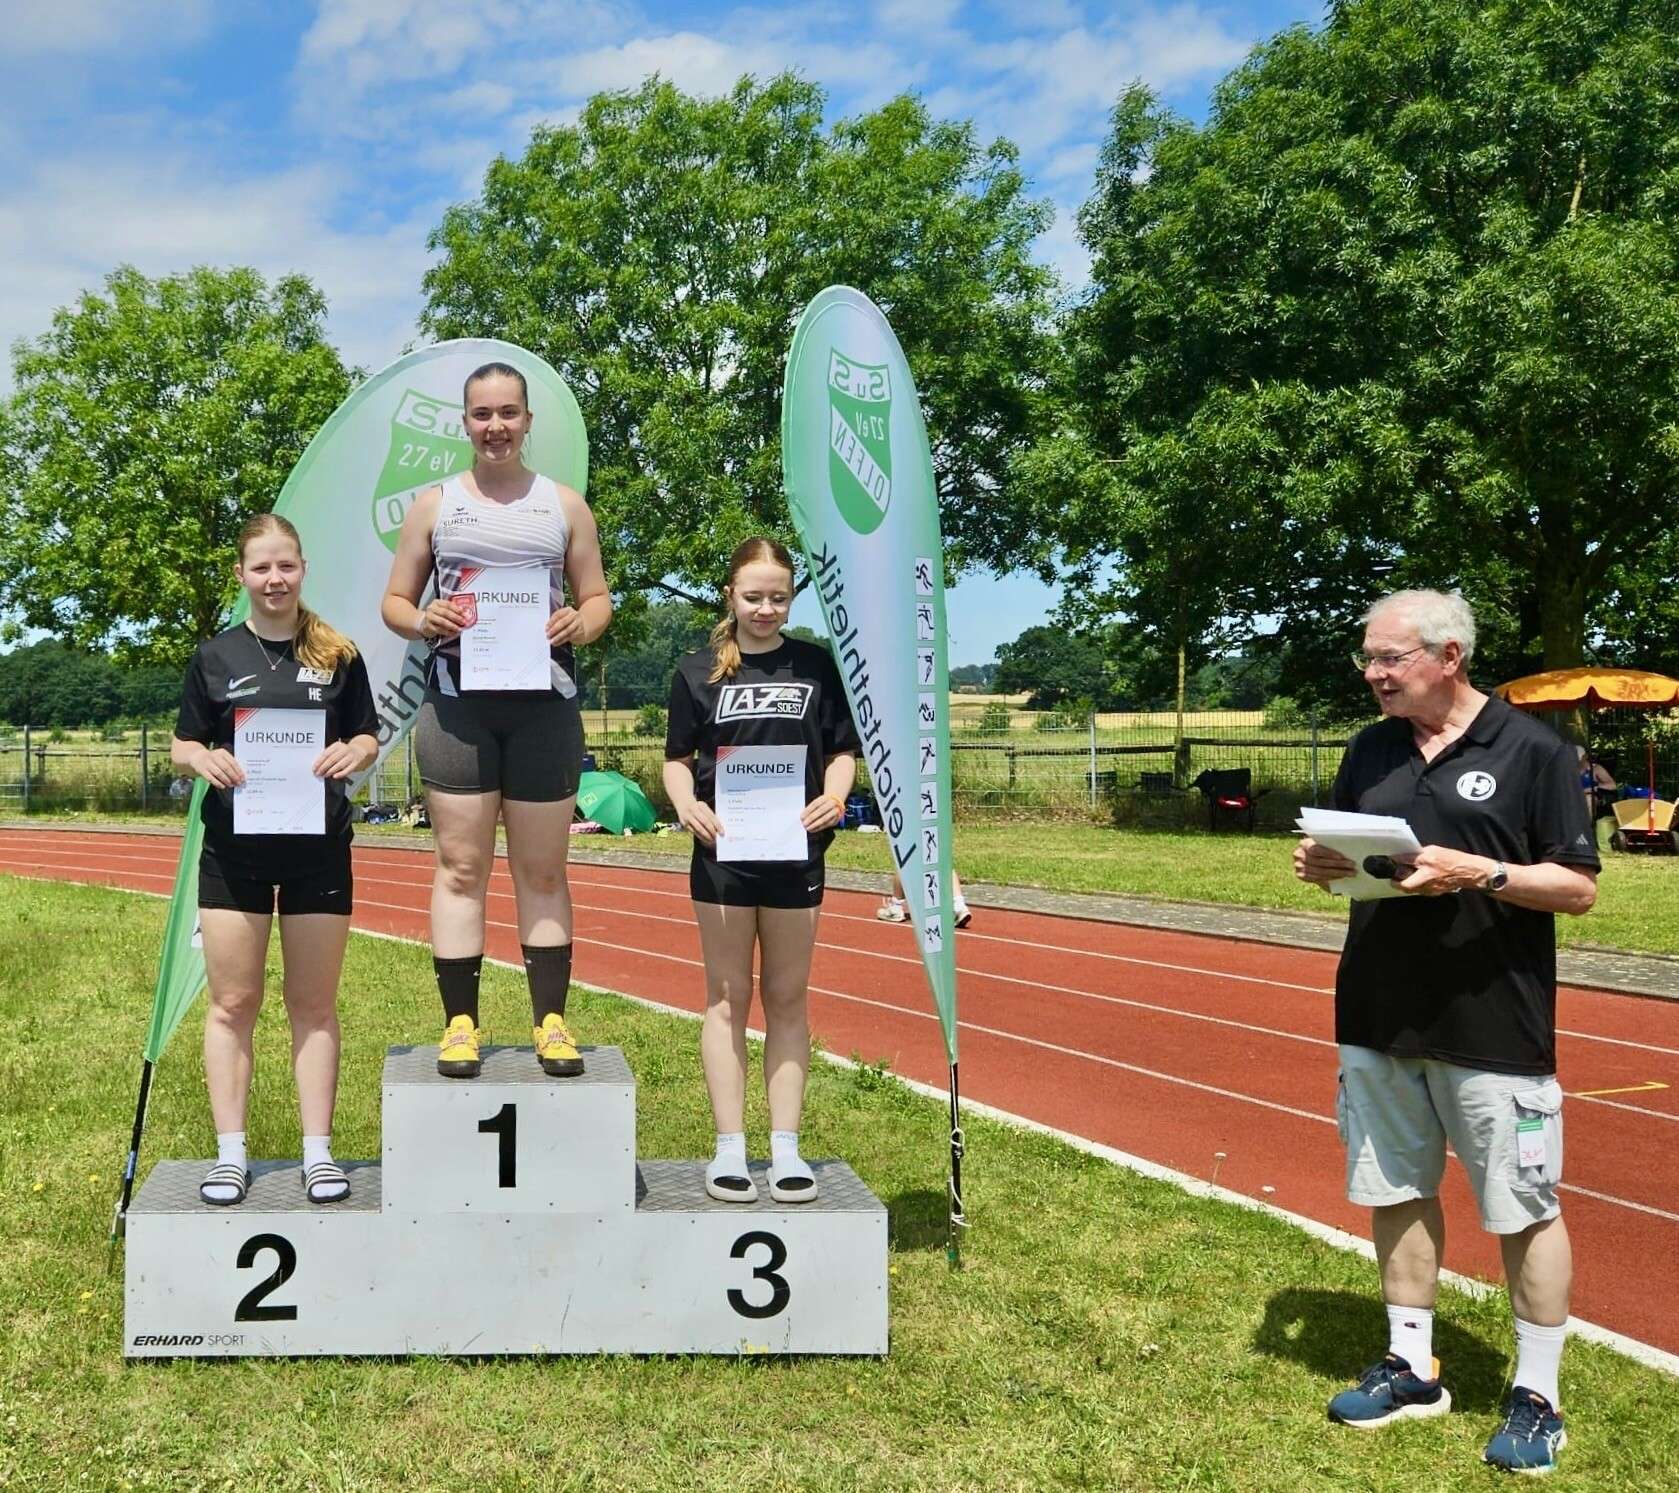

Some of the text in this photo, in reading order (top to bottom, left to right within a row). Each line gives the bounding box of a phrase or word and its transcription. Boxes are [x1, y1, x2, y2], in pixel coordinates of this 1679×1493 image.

[398, 443, 429, 468] 27
[308, 687, 323, 702] HE
[722, 687, 781, 718] LAZ
[776, 702, 802, 714] SOEST
[245, 732, 315, 744] URKUNDE
[726, 763, 796, 775] URKUNDE
[477, 1103, 517, 1188] 1
[234, 1233, 298, 1322] 2
[727, 1231, 791, 1319] 3
[133, 1334, 245, 1346] ERHARD SPORT
